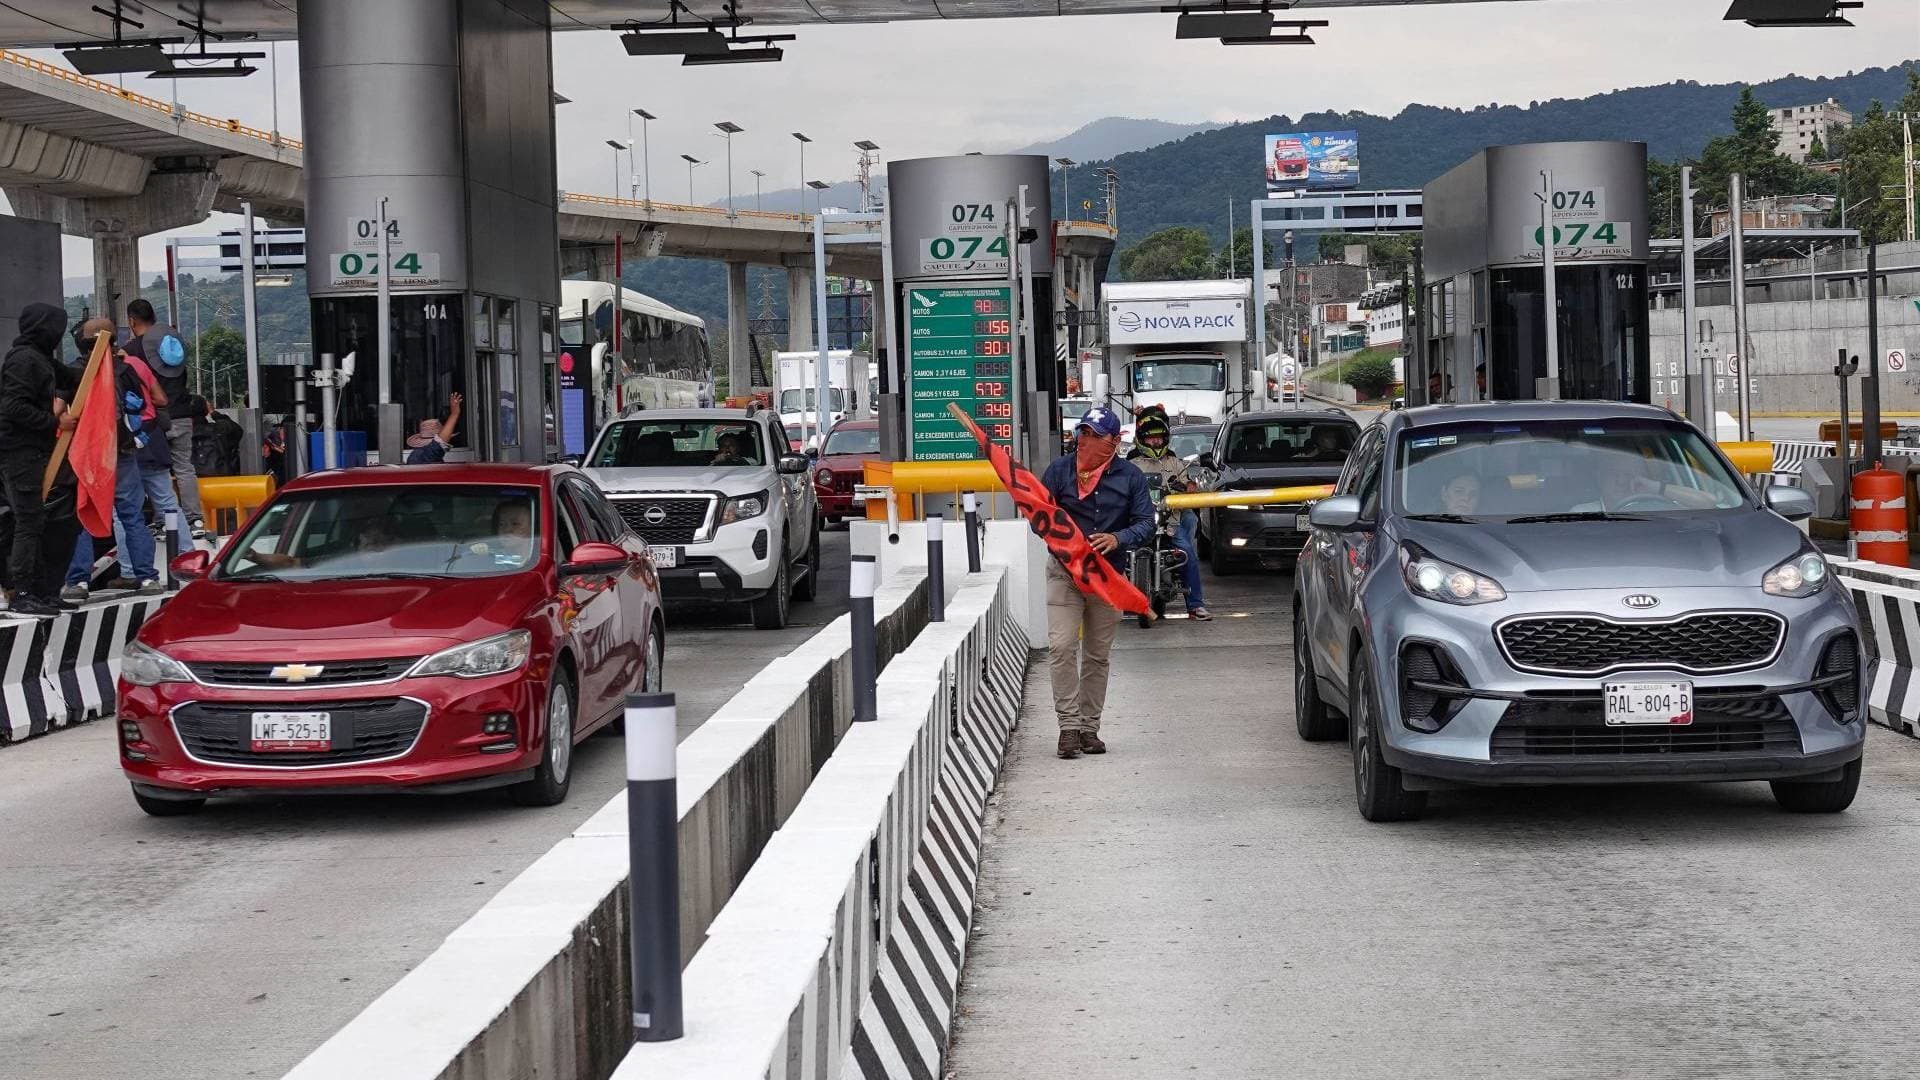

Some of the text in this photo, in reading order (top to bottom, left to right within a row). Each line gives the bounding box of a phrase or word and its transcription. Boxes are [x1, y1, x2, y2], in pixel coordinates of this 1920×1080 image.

[1552, 190, 1596, 210] 074
[952, 204, 995, 223] 074
[1534, 222, 1618, 247] 074
[930, 236, 1009, 260] 074
[1616, 274, 1634, 289] 12 A
[423, 303, 447, 320] 10 A
[988, 320, 1009, 334] 156
[1145, 314, 1235, 329] NOVA PACK
[984, 341, 1010, 355] 301
[925, 431, 955, 439] EXCEDENTE
[1628, 596, 1655, 605] KIA
[1609, 694, 1689, 713] RAL-804-B
[255, 723, 327, 739] LWF-525-B
